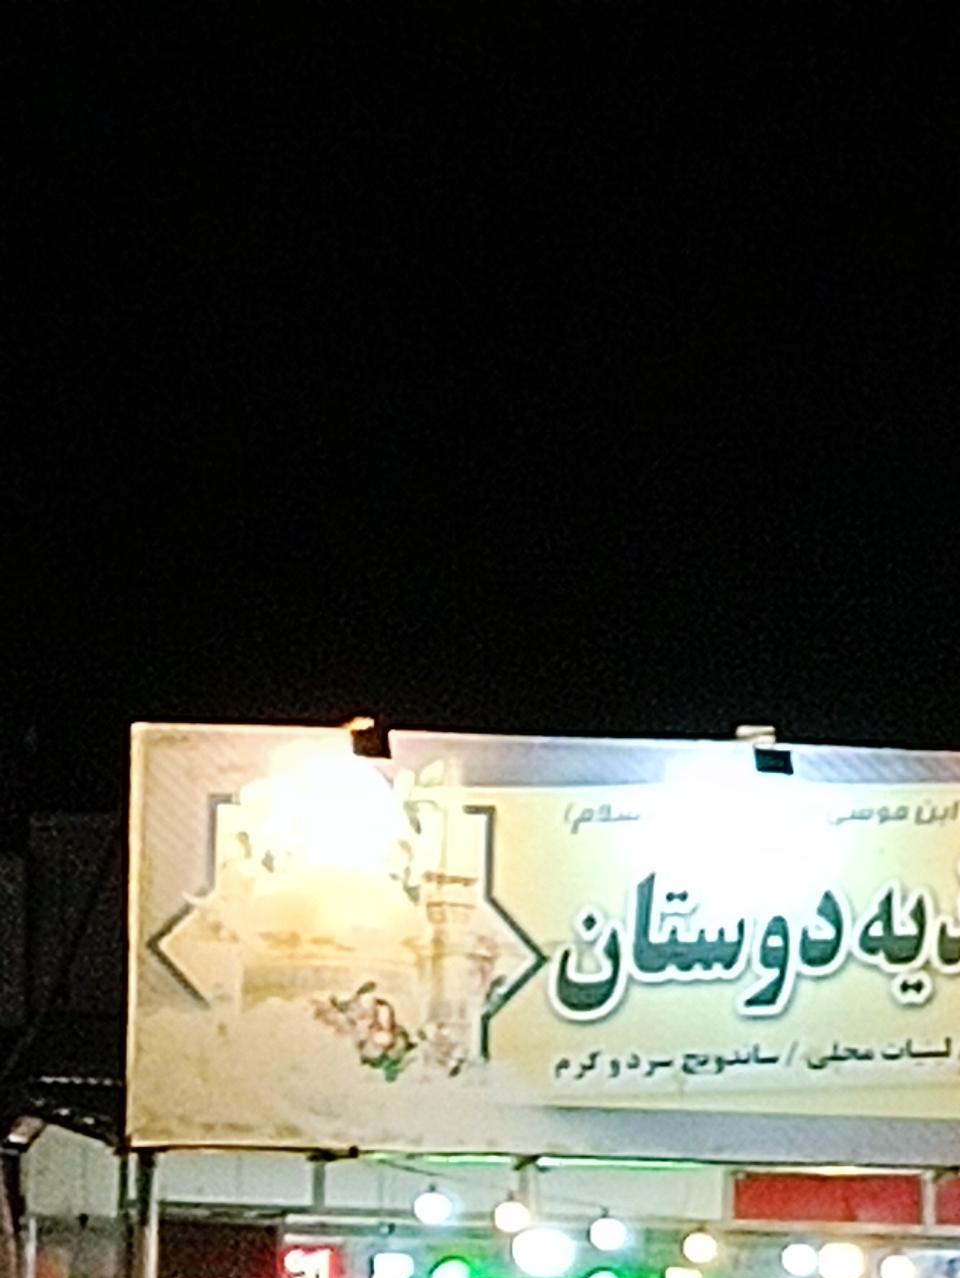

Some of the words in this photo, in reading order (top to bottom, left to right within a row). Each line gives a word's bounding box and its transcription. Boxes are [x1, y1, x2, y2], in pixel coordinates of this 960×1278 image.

[556, 871, 843, 1012] دوستان
[682, 1043, 779, 1075] ساندویچ
[807, 1040, 874, 1070] محلی
